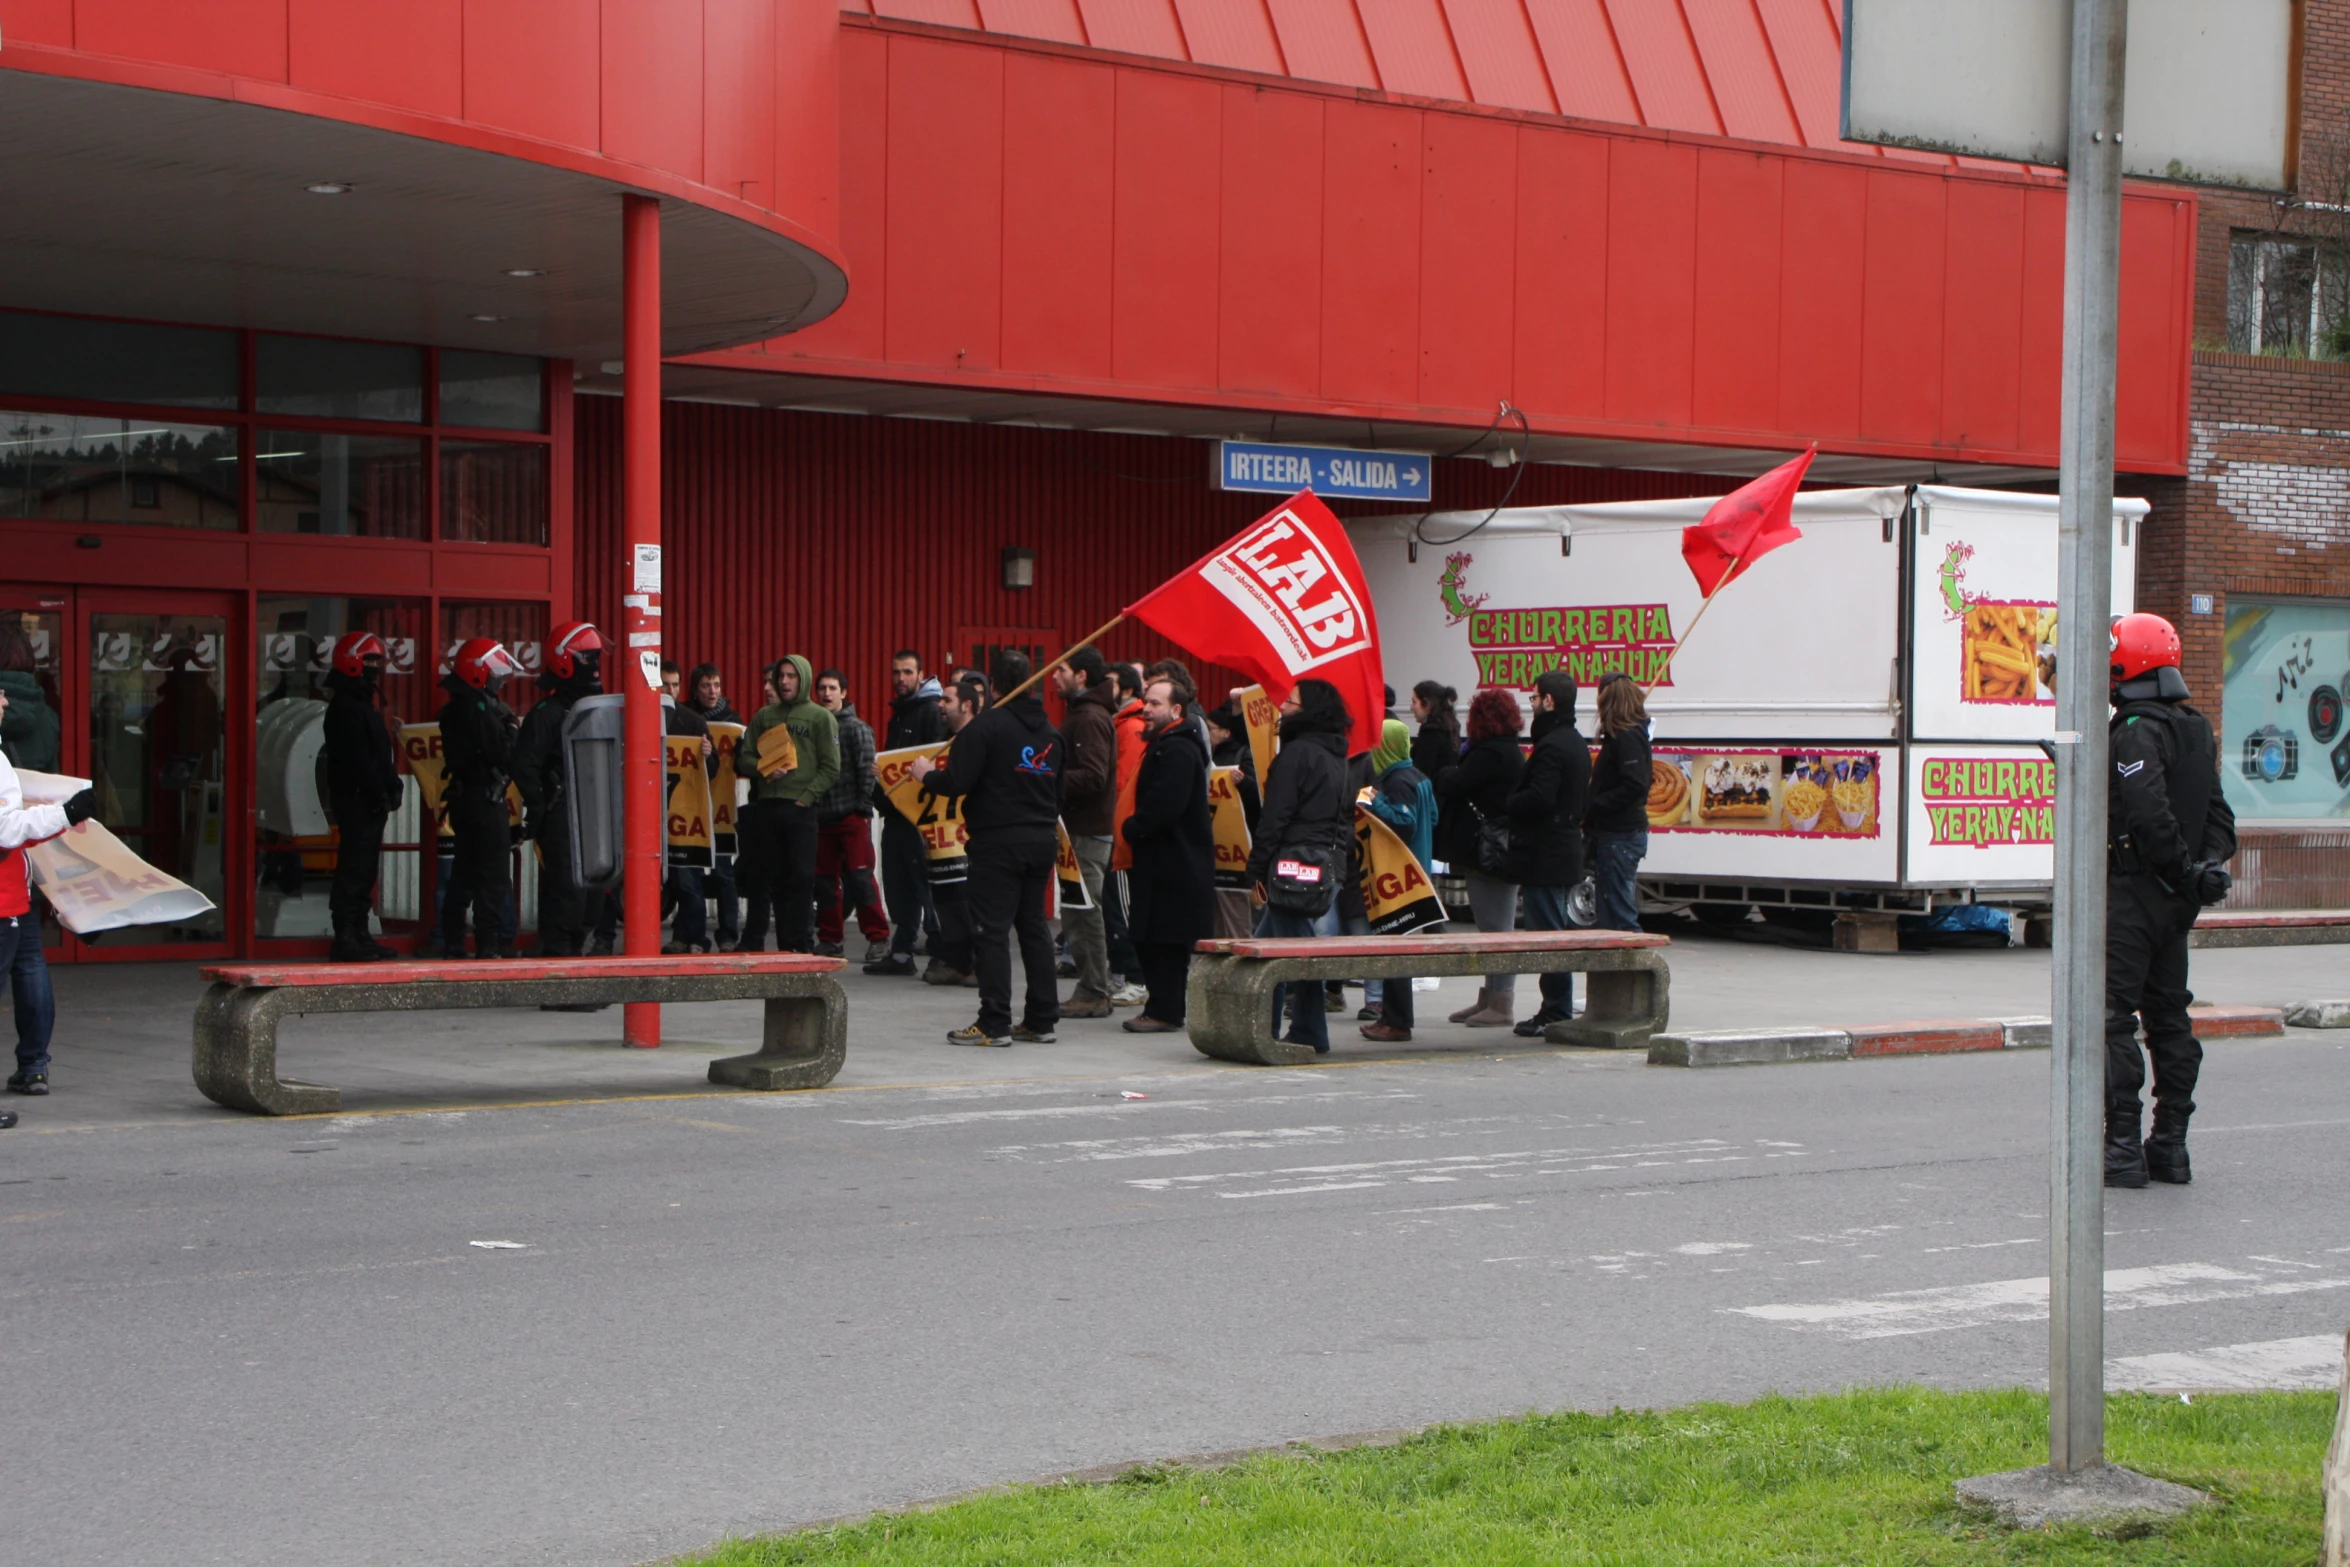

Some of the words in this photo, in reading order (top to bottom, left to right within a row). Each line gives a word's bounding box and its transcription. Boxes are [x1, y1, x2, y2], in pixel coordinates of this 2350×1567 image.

[1230, 452, 1313, 485] IRTEERA
[1329, 459, 1398, 489] SALIDA
[1234, 520, 1355, 648] LAB
[1215, 557, 1237, 577] langile
[1235, 573, 1271, 610] abertzaleen
[1269, 608, 1308, 662] batzordeak
[2196, 597, 2210, 611] 110
[1471, 607, 1671, 646] CHURRERIA
[1924, 761, 2055, 799] CHURRE
[1929, 806, 2055, 844] YERAY-NA
